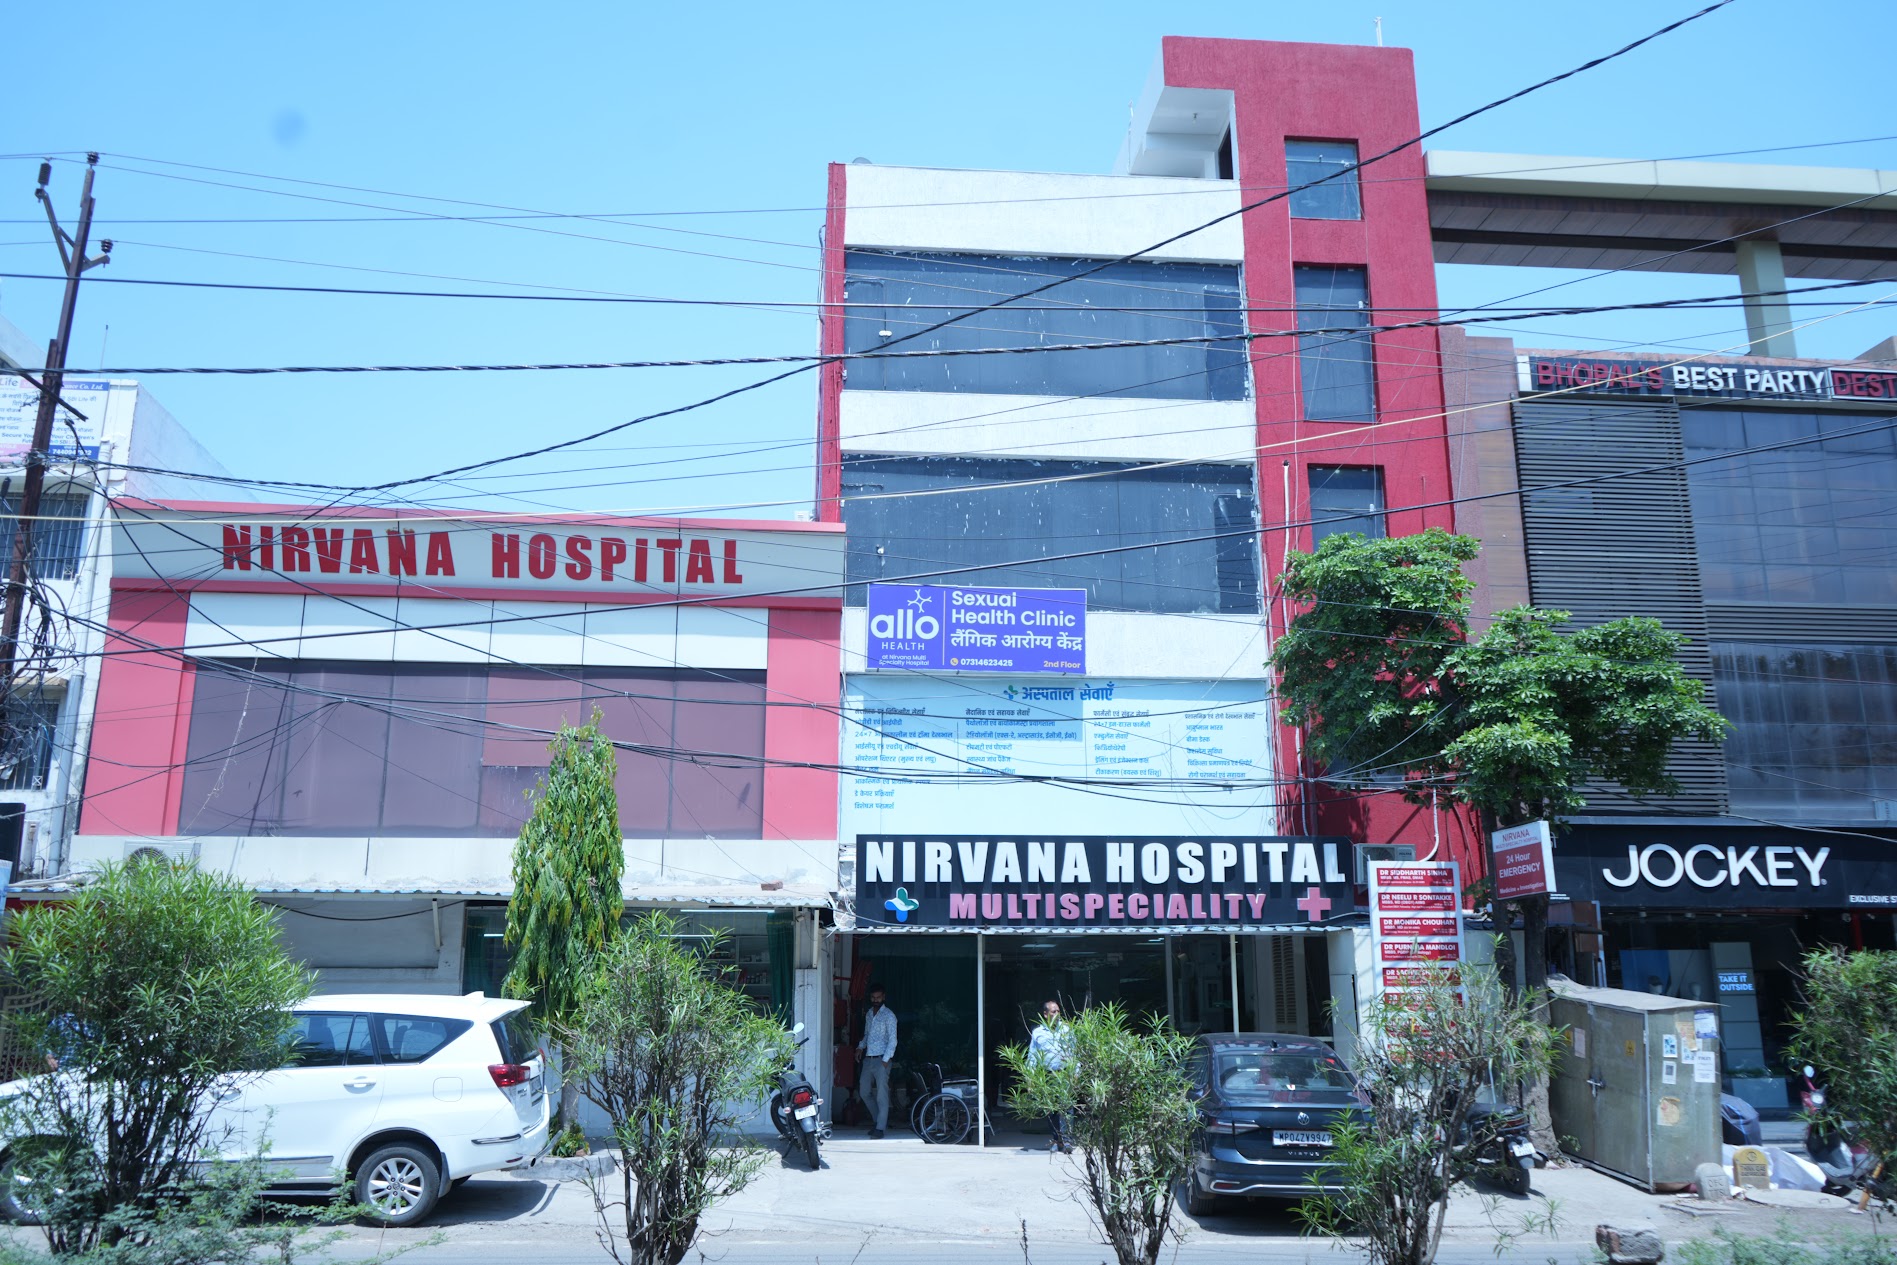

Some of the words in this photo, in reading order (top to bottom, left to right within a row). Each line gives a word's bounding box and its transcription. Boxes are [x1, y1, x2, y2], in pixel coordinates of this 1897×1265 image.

[1537, 361, 1664, 389] BHOPAL'S
[1672, 365, 1738, 391] BEST
[1744, 368, 1825, 394] PARTY
[223, 524, 456, 576] NIRVANA
[491, 533, 742, 584] HOSPITAL
[871, 609, 939, 639] allo
[952, 608, 1016, 625] Health
[1020, 610, 1076, 627] Clinic
[882, 642, 925, 650] HEALTH
[950, 628, 998, 647] लैंगिक
[1001, 630, 1053, 649] आरोग्य
[1056, 632, 1083, 651] केंद्र
[960, 658, 1013, 667] 07314623425
[1044, 660, 1058, 668] 2nd
[1022, 686, 1076, 700] अस्पताल
[1502, 828, 1530, 842] NIRVANA
[866, 842, 1092, 883] NIRVANA
[1106, 842, 1346, 884] HOSPITAL
[1506, 855, 1514, 864] 24
[1514, 852, 1530, 862] Hour
[1602, 843, 1831, 888] JOCKEY
[1499, 862, 1540, 878] EMERGENCY
[950, 893, 1267, 920] MULTISPECIALITY
[1849, 894, 1890, 904] EXCLUSIVE
